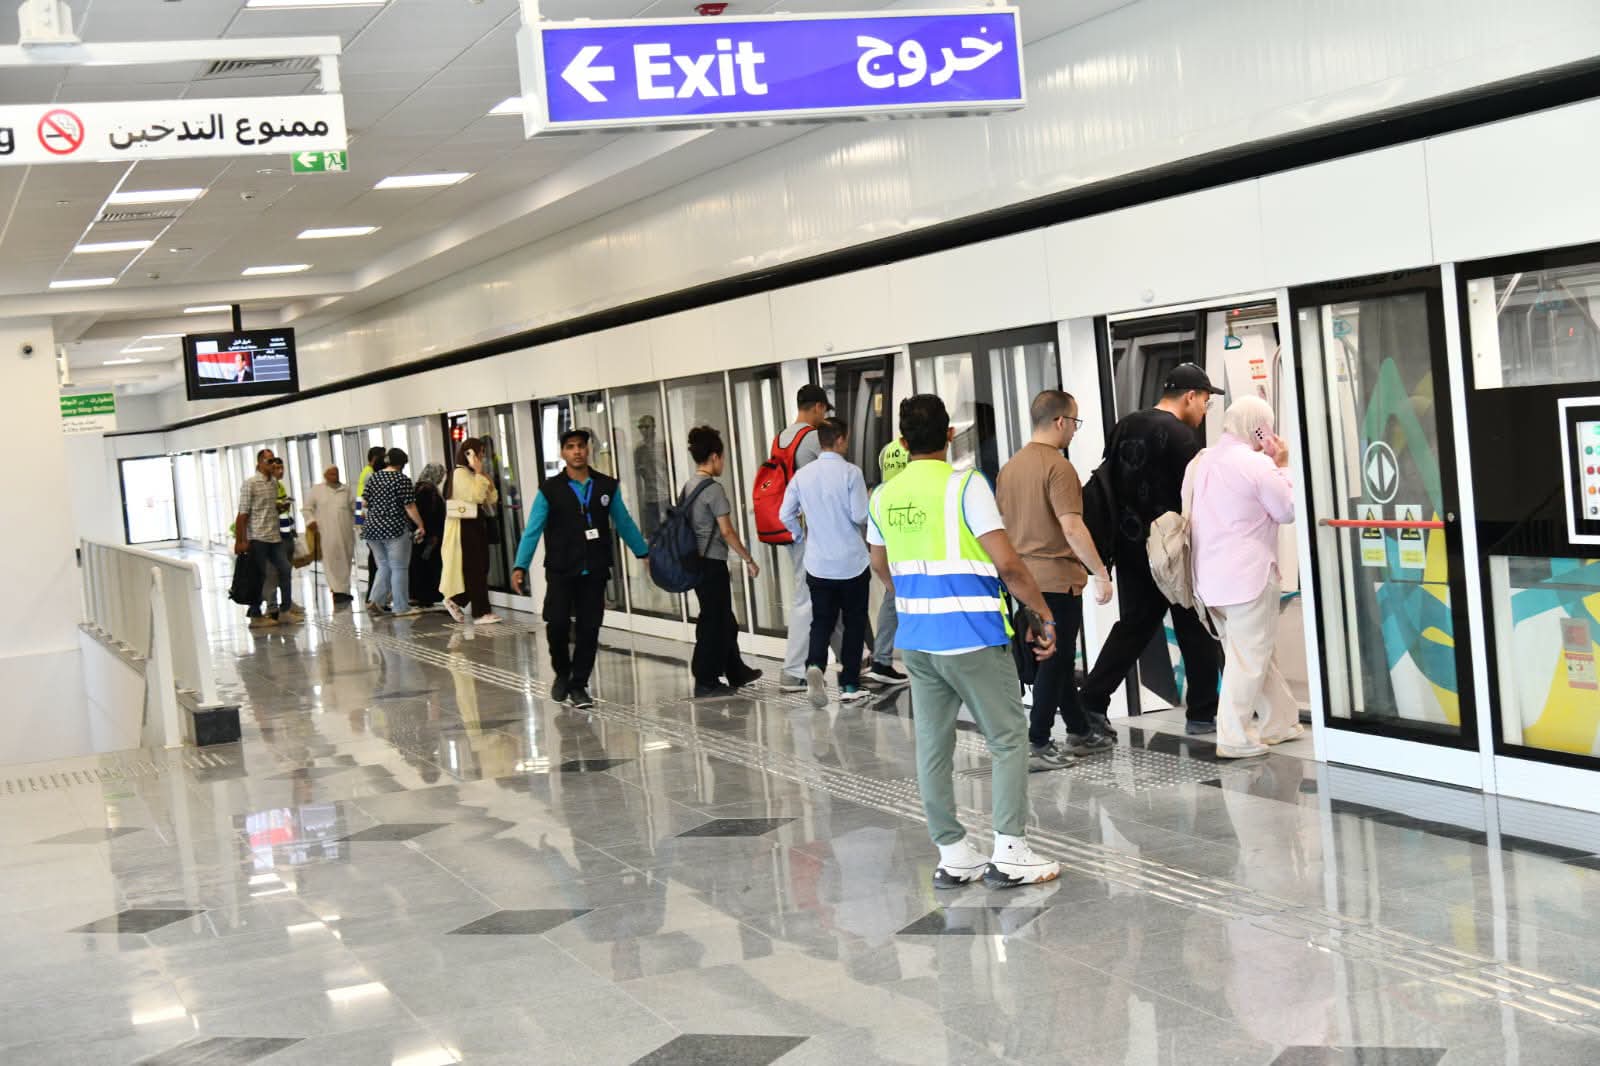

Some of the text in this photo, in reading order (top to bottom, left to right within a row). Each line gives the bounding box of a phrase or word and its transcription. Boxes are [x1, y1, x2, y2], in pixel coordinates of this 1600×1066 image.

[633, 38, 768, 100] Exit
[856, 26, 1003, 89] خروج
[109, 114, 329, 150] ممنوع التدخين
